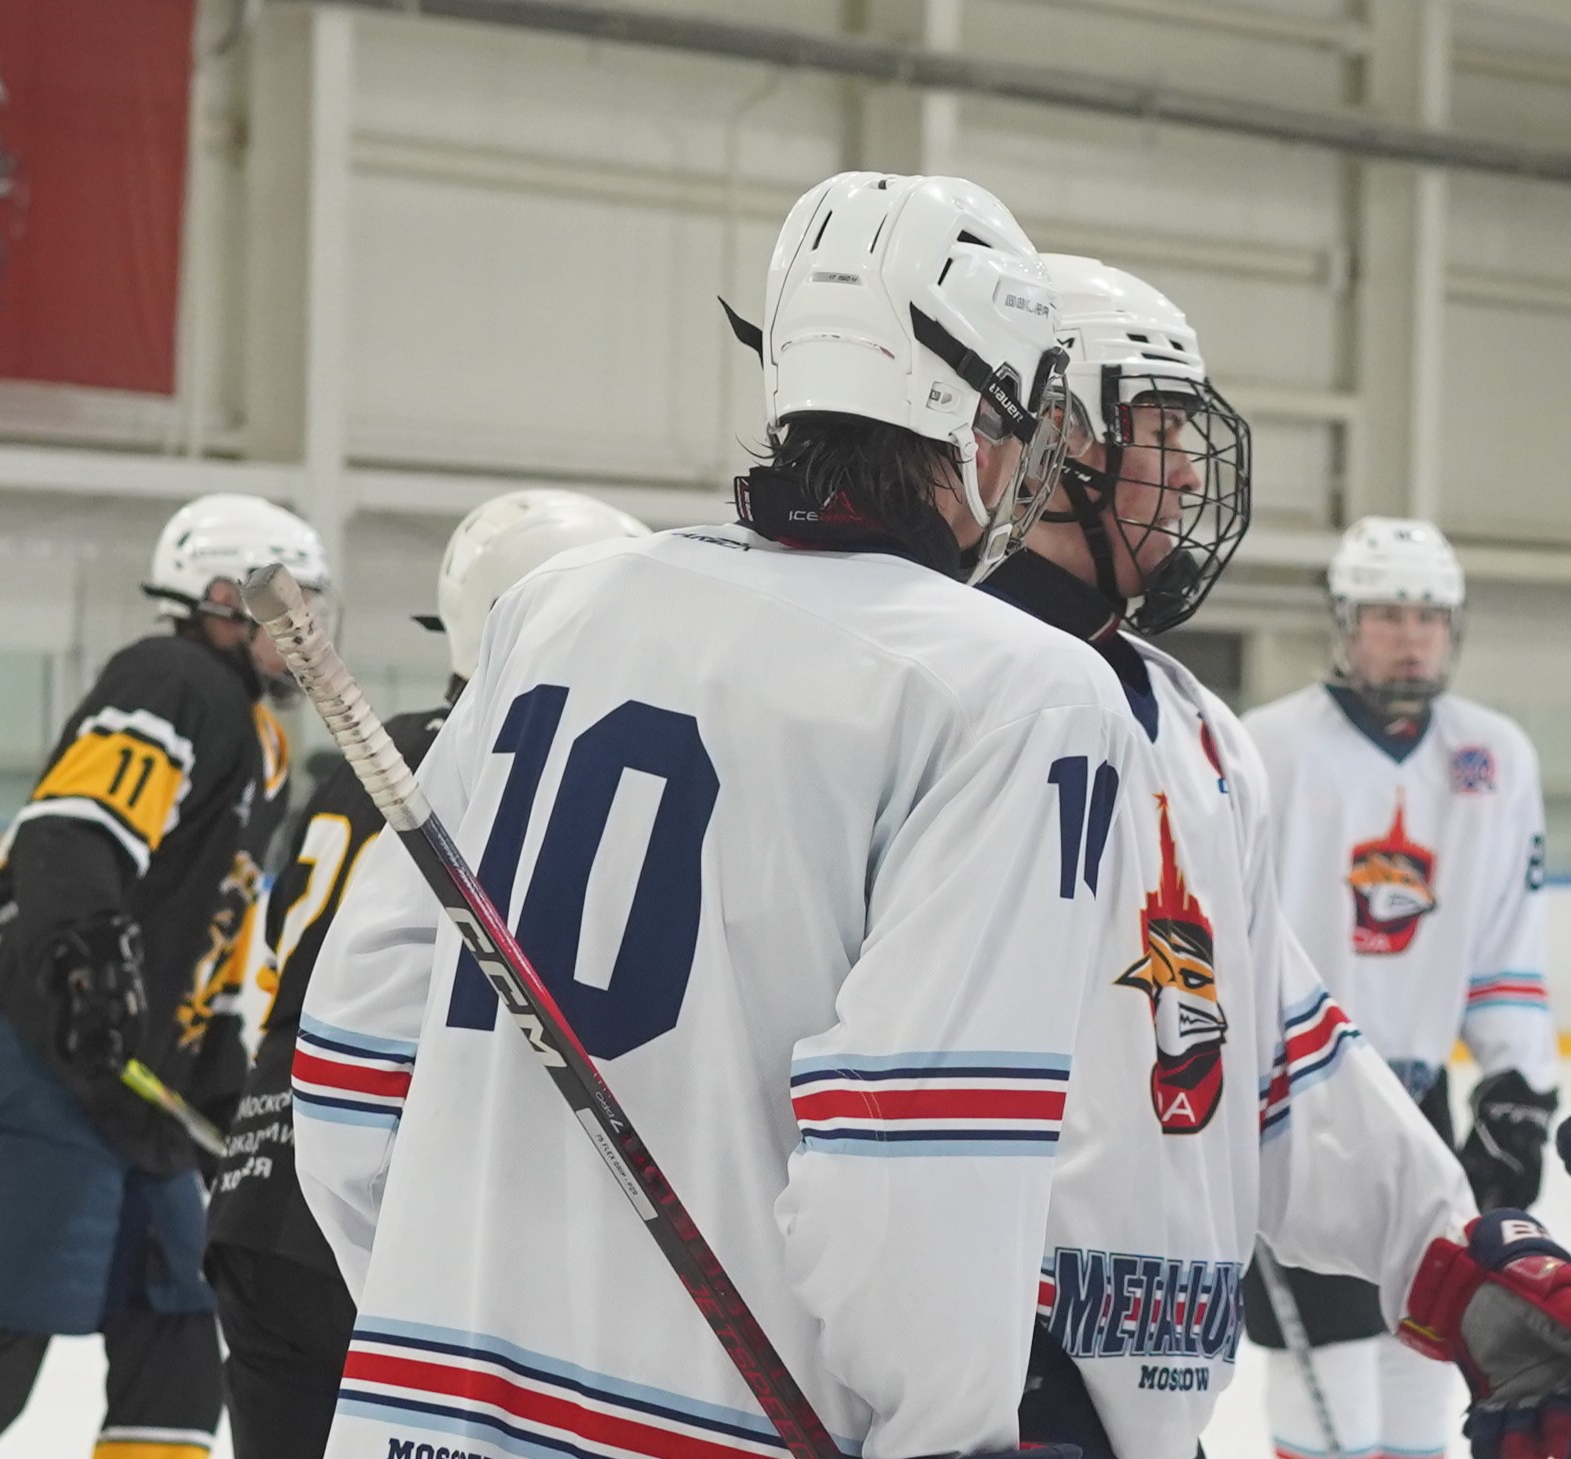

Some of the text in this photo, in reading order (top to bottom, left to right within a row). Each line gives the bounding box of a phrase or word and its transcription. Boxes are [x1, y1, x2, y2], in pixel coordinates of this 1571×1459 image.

[108, 747, 154, 808] 11
[445, 683, 720, 1061] 10
[446, 906, 567, 1067] CCM
